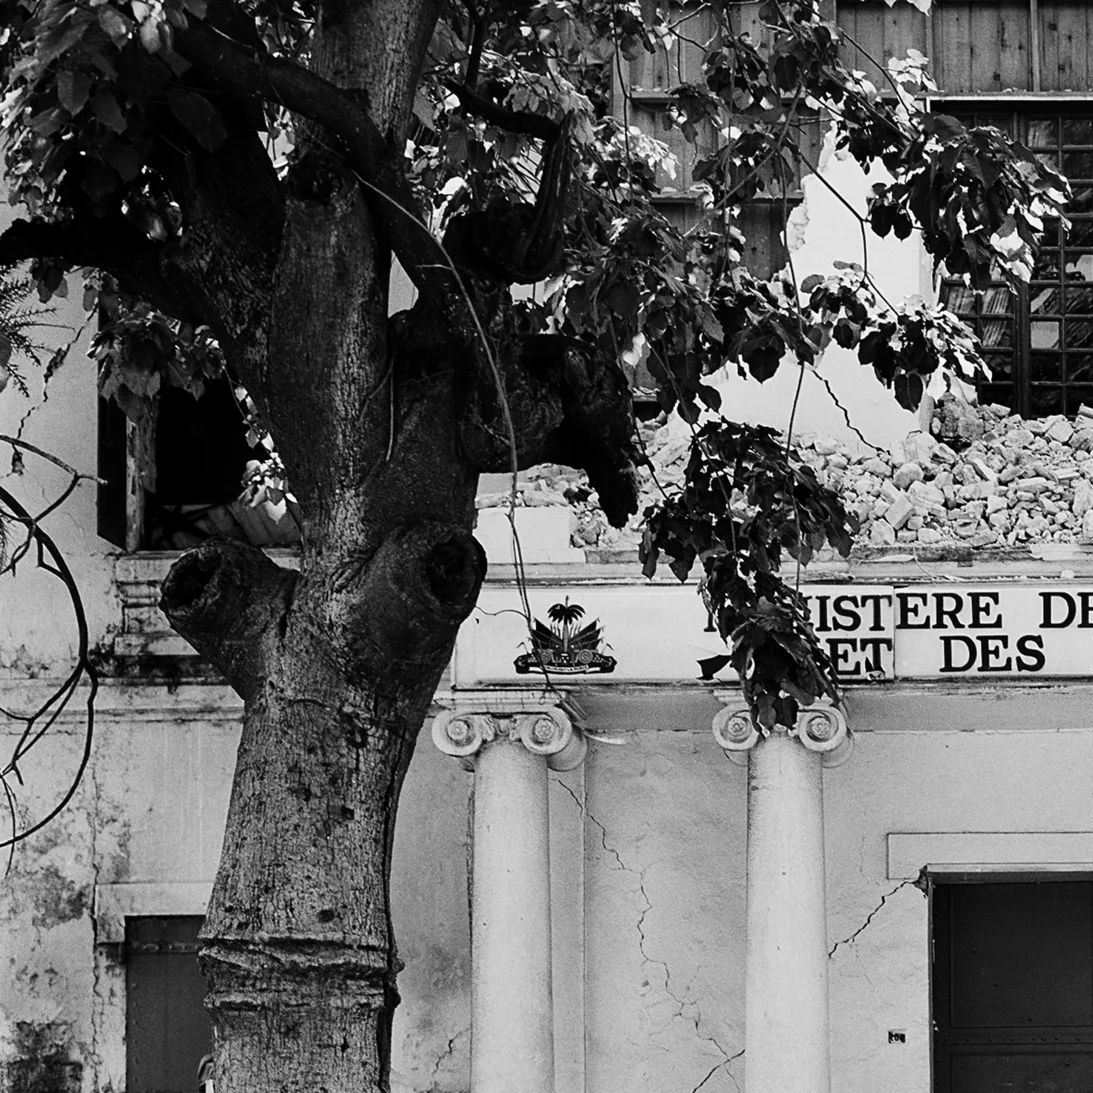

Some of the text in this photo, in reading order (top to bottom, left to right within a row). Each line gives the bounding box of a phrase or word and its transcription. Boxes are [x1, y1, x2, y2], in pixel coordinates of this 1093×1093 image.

[704, 591, 1003, 633] ISTERE
[825, 637, 893, 676] ET
[939, 634, 1046, 673] DES
